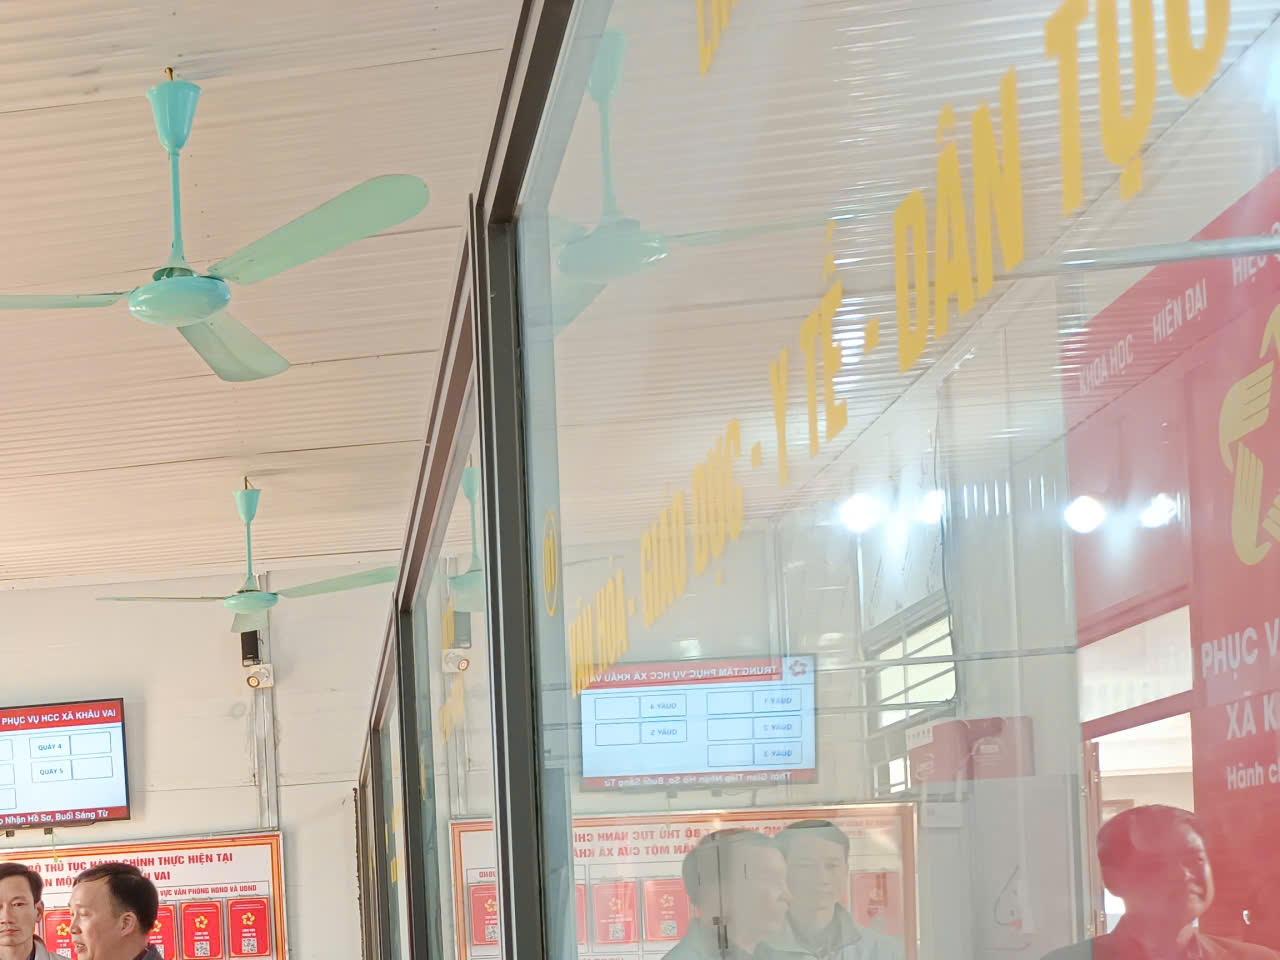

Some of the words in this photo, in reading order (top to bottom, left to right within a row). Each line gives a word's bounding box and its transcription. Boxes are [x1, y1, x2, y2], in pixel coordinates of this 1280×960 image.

[770, 347, 788, 488] Y
[800, 220, 848, 458] TẾ
[894, 65, 1025, 374] DÂN
[1080, 353, 1108, 395] KHOA
[1110, 334, 1135, 375] HỌC
[1152, 297, 1183, 344] HIỆN
[1185, 278, 1208, 320] ĐẠI
[1201, 627, 1258, 680] PHỤC
[1264, 618, 1280, 657] V
[2, 716, 26, 726] PHỤC
[28, 715, 39, 725] VỤ
[41, 713, 60, 723] HCC
[62, 710, 74, 721] XÃ
[75, 709, 100, 719] KHÂU
[102, 708, 116, 718] VAI
[1225, 689, 1257, 740] XÃ
[1226, 761, 1264, 791] Hành
[45, 860, 64, 872] THỦ
[68, 861, 87, 873] TỤC
[158, 855, 185, 867] THỰC
[188, 852, 213, 865] HIỆN
[216, 853, 233, 864] TẠI
[154, 871, 171, 880] VAI
